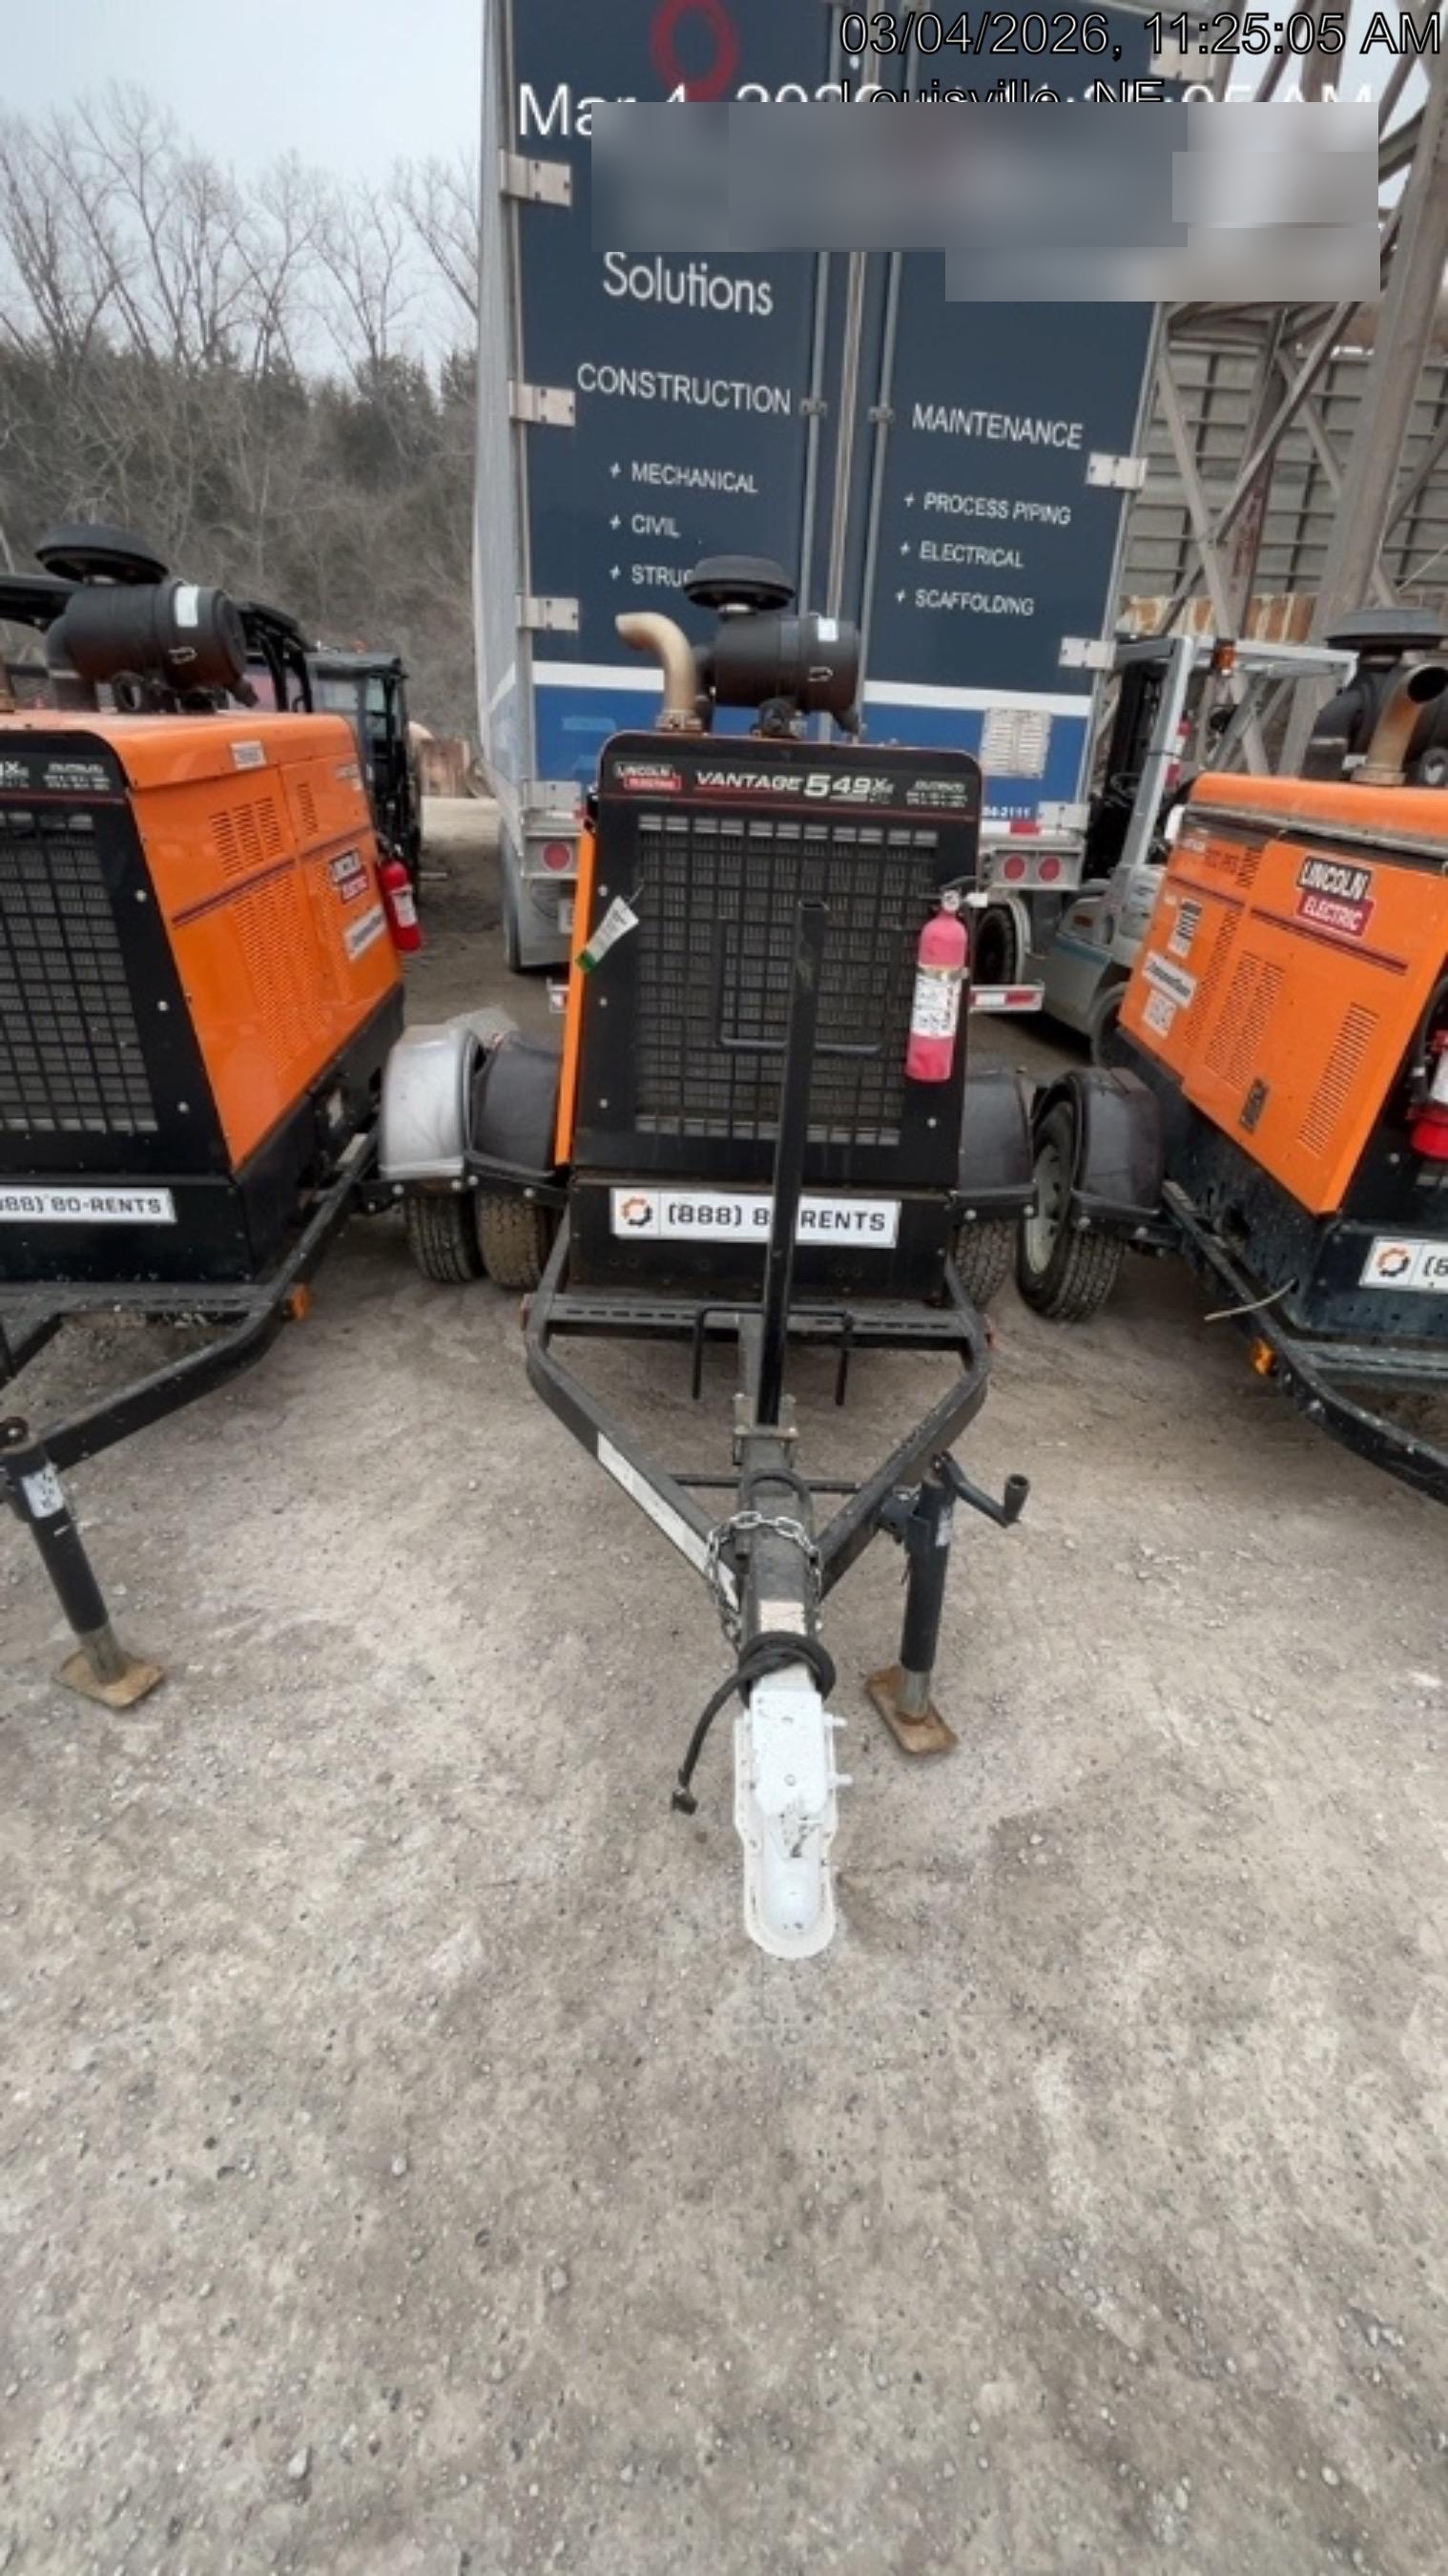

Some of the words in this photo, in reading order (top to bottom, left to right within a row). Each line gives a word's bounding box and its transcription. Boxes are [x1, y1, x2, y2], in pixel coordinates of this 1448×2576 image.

[603, 252, 773, 316] Solutions
[577, 363, 792, 415] CONSTRUCTION
[912, 404, 1084, 449] MAINTENANCE
[631, 463, 758, 494] MECHANICAL
[923, 492, 1008, 519] PROCESS
[1012, 500, 1071, 526] PIPING
[631, 514, 680, 538] CIVIL
[919, 541, 1024, 569] ELECTRICAL
[914, 589, 1035, 615] SCAFFOLDING
[696, 770, 803, 792] VANTAGE
[1299, 860, 1370, 901] LINCOLN
[1302, 895, 1364, 931] ELECTRIC
[0, 1195, 44, 1214] 88)
[668, 1203, 742, 1227] (888)
[752, 1206, 886, 1232] 8RENTS
